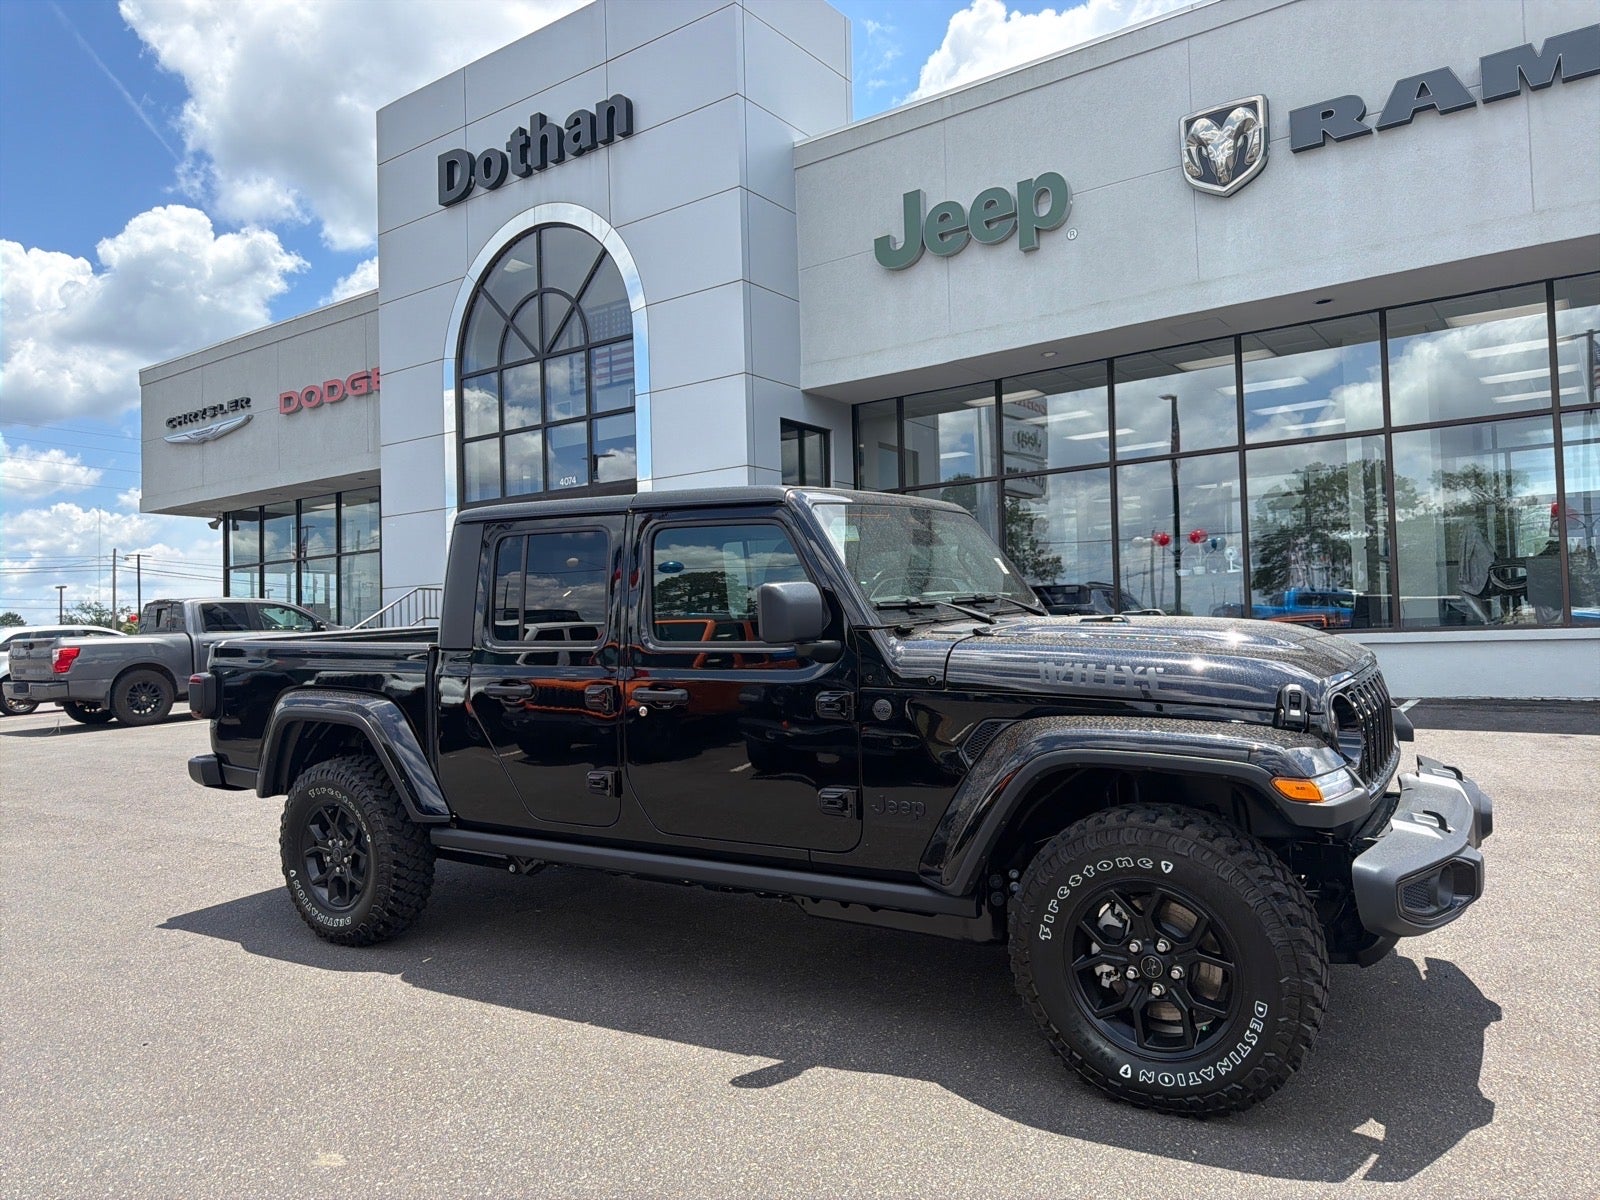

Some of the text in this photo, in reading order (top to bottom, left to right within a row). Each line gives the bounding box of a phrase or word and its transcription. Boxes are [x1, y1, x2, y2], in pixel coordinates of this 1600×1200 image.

[1289, 23, 1600, 154] RAM
[438, 93, 633, 207] Dothan
[874, 171, 1073, 271] Jeep
[165, 396, 252, 429] CHRYSLER
[559, 475, 577, 486] 4074
[871, 794, 927, 821] Jeep
[1038, 856, 1154, 942] Firestone
[1138, 1000, 1269, 1087] DESTINATION
